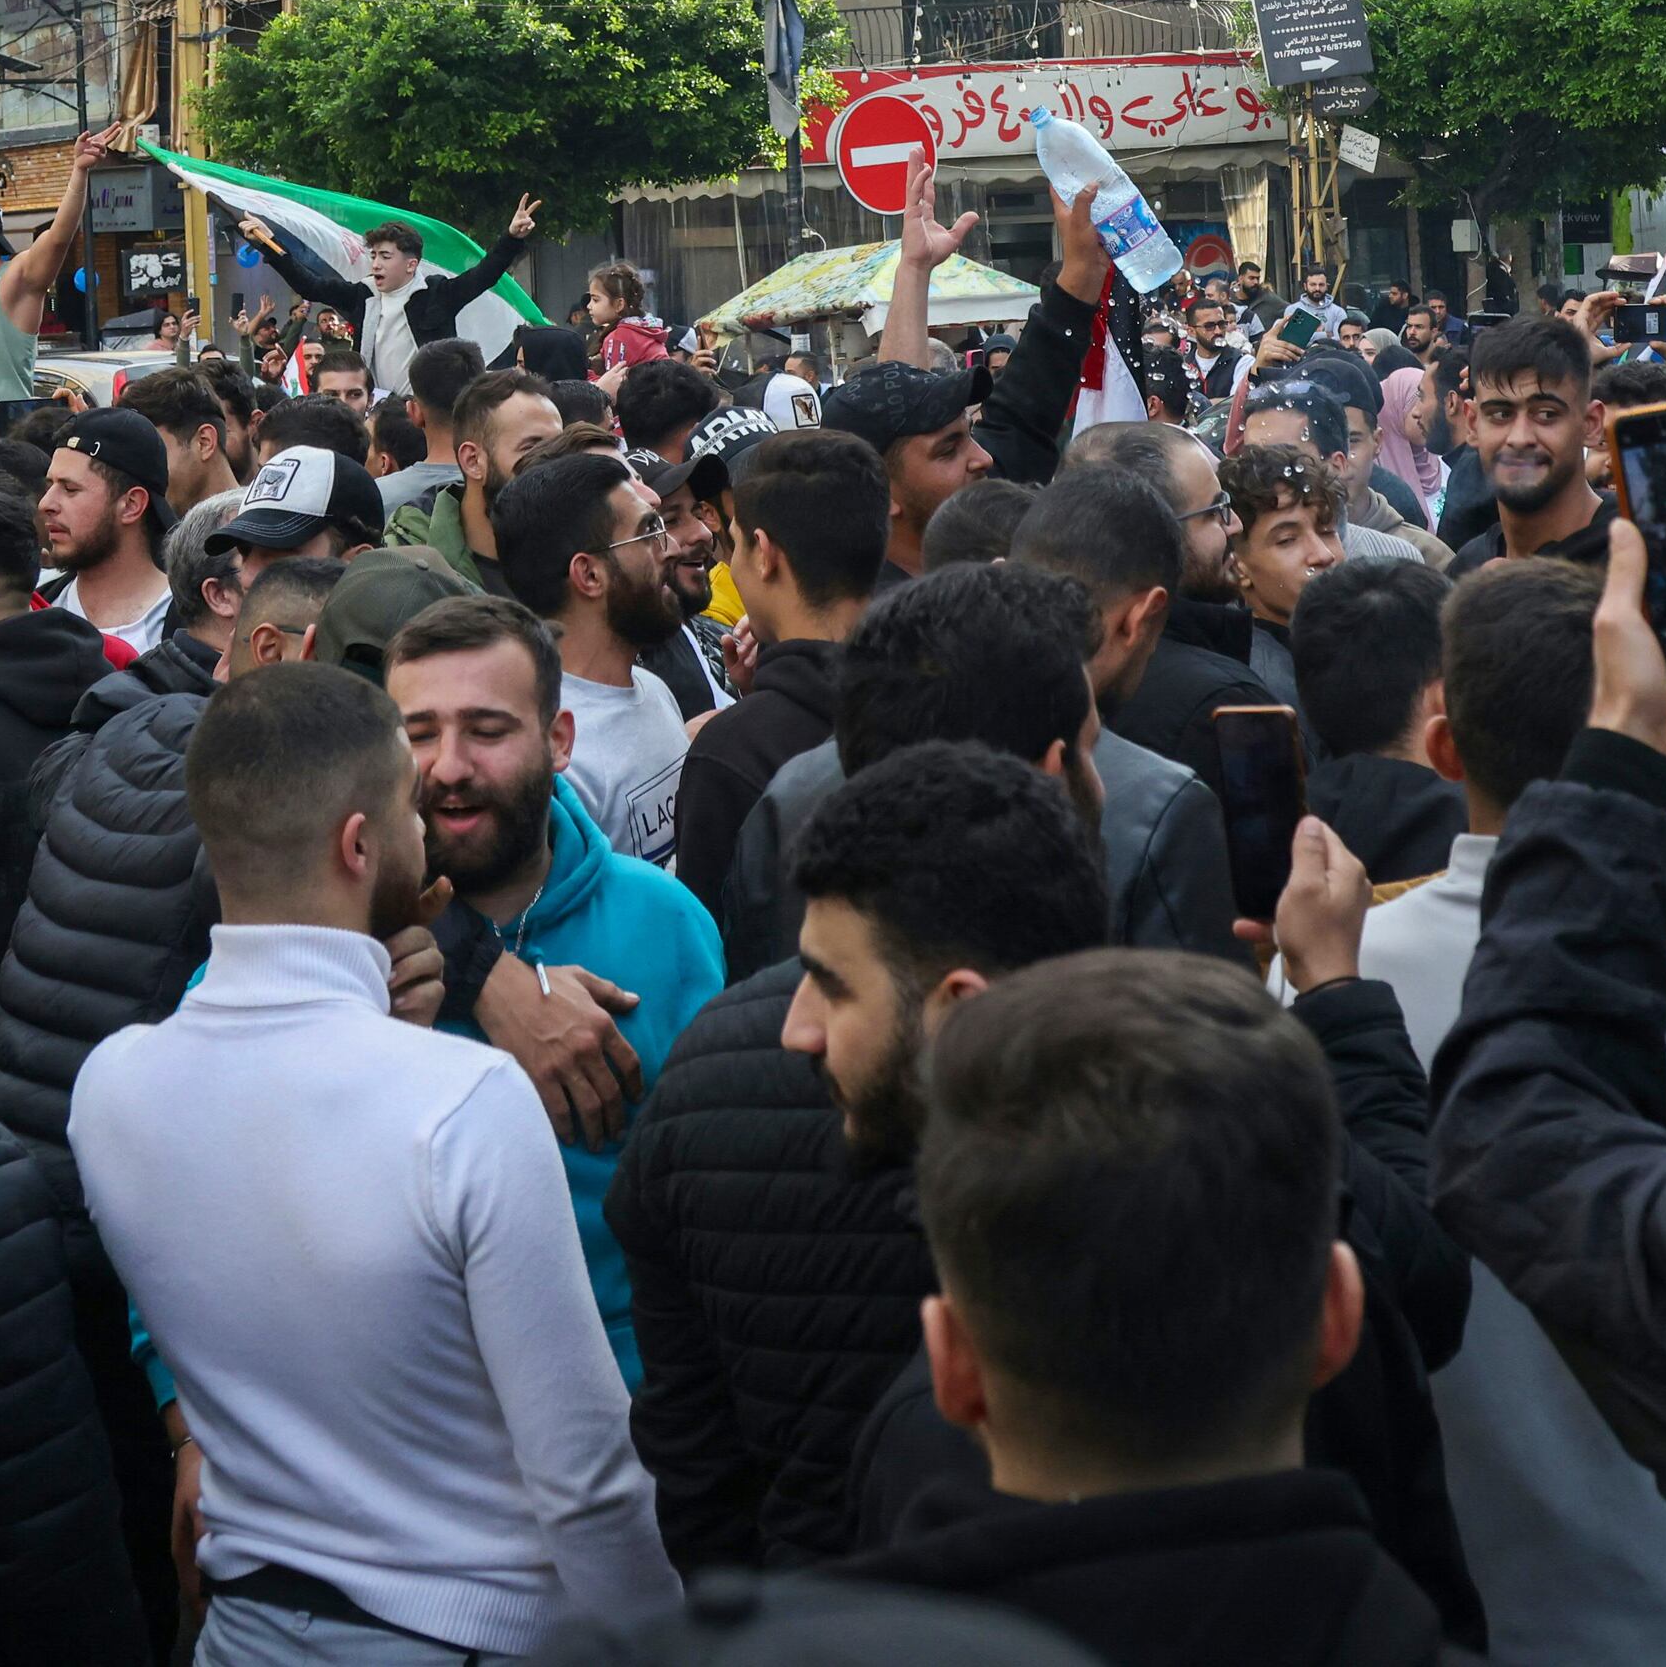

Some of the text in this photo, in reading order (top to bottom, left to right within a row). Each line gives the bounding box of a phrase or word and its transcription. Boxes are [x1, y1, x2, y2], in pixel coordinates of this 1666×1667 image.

[1327, 4, 1347, 14] الدكتور
[1275, 13, 1290, 21] حسن
[1293, 9, 1308, 20] الحاج
[1331, 32, 1347, 41] مجمع
[1274, 40, 1362, 59] 01/706703 & 76/875450
[1340, 86, 1366, 96] مجمع
